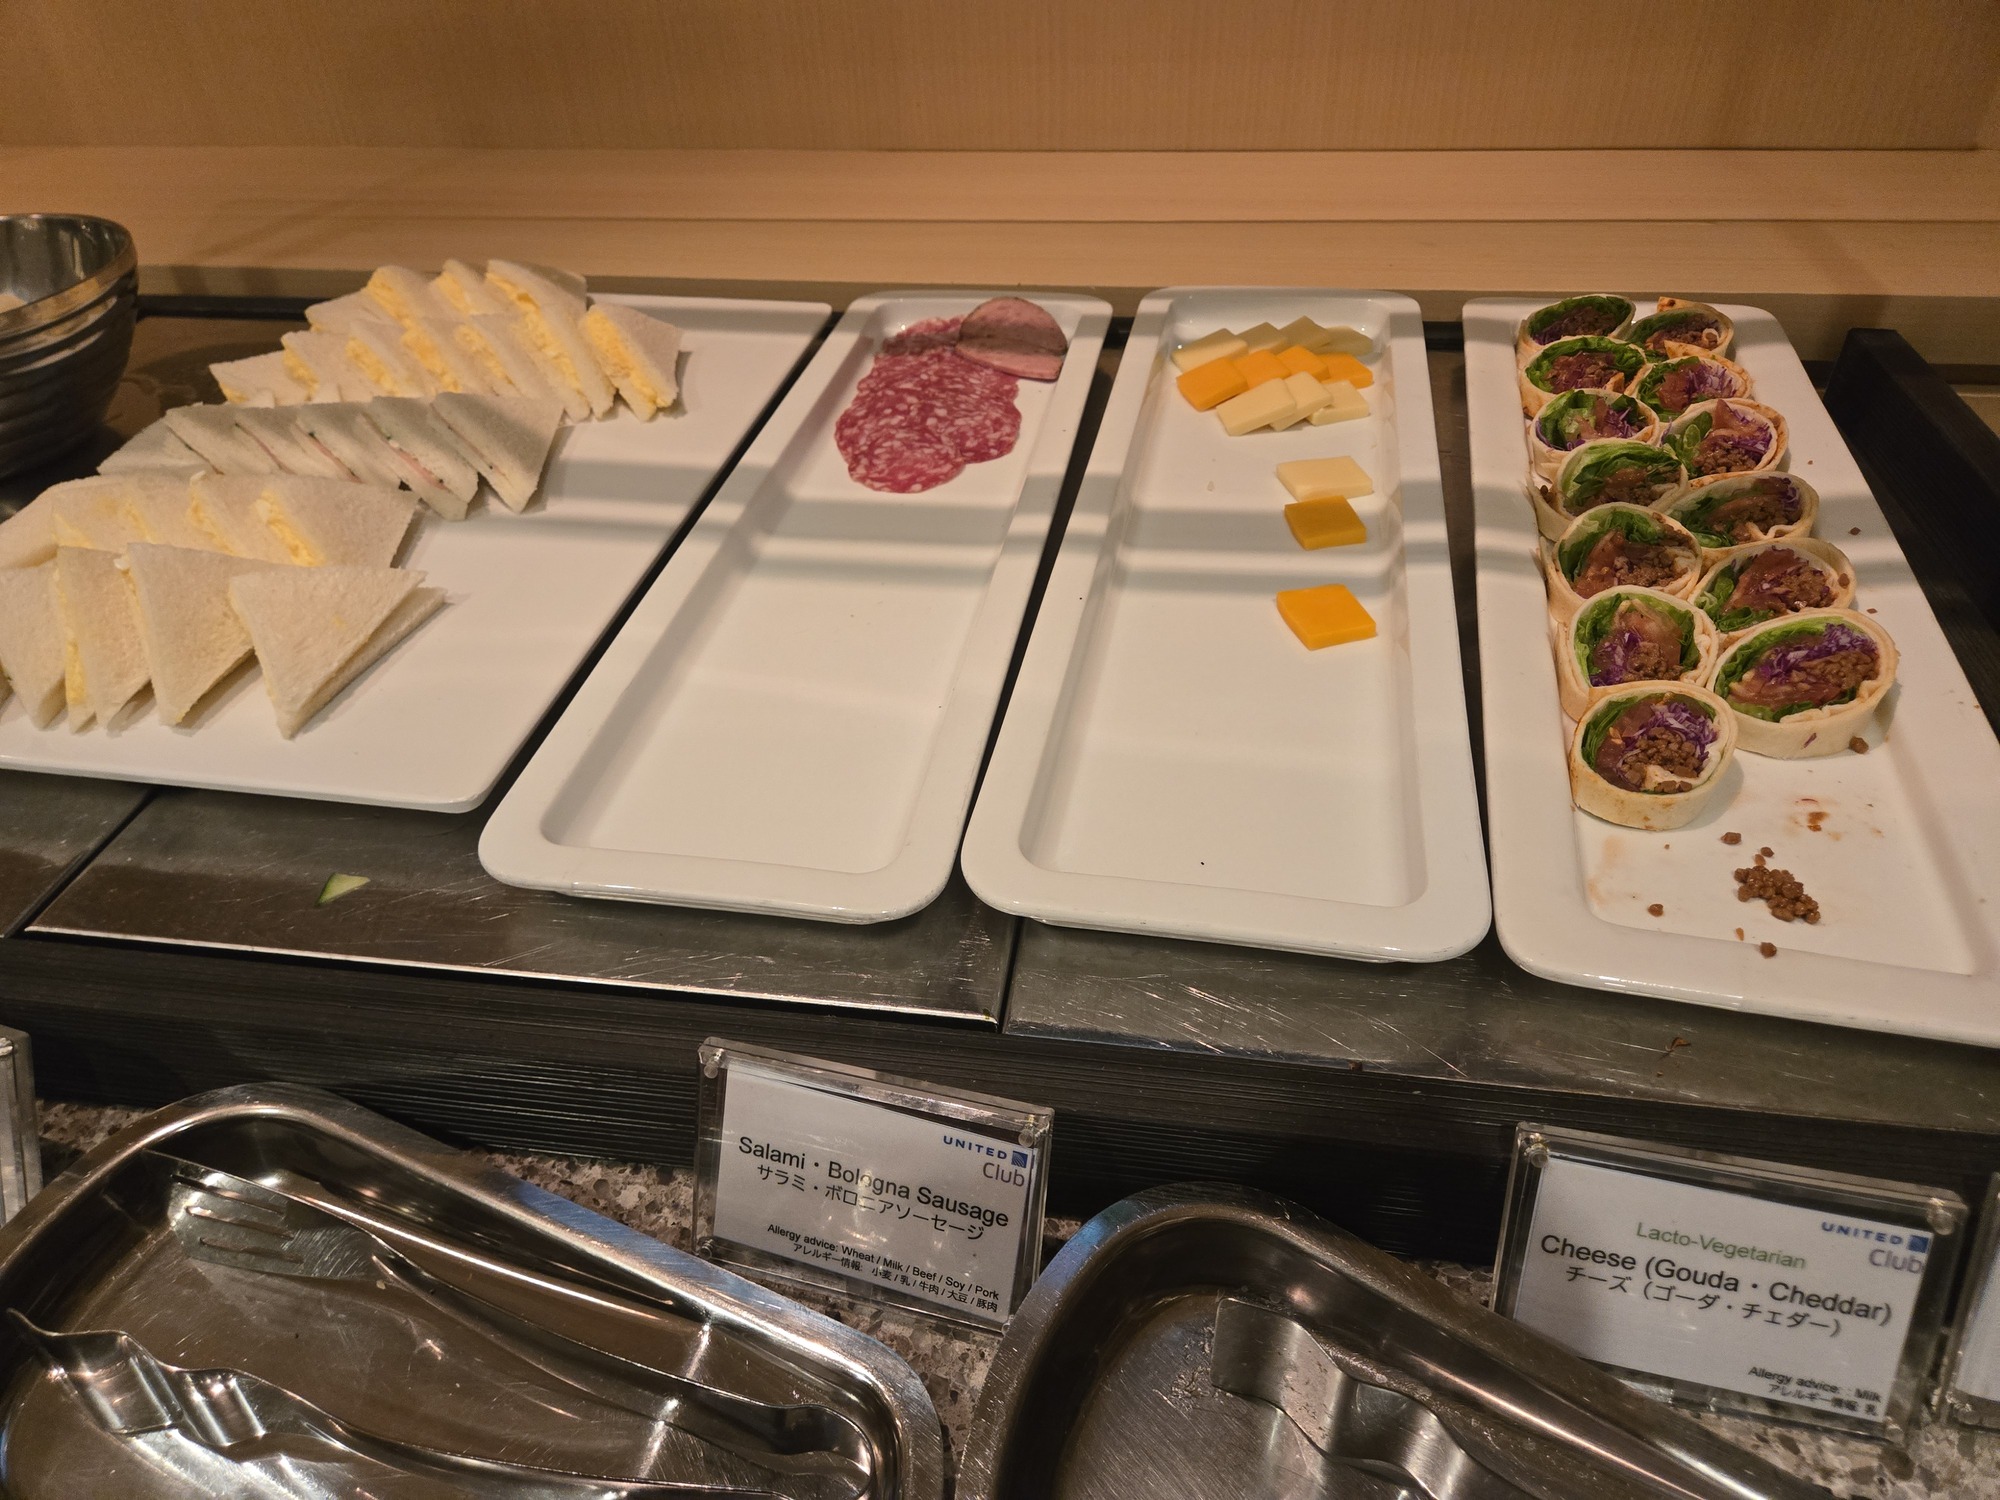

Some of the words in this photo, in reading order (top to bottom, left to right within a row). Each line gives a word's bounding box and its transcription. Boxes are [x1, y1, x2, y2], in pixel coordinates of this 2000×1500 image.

[943, 1135, 1008, 1160] UNITED
[739, 1136, 805, 1170] Salami
[828, 1161, 910, 1199] Bologna
[917, 1187, 1009, 1227] Sausage
[982, 1162, 1025, 1187] Club
[1636, 1223, 1807, 1270] Lacto-Vegetarian
[1821, 1221, 1904, 1246] UNITED
[767, 1224, 801, 1242] Allergy
[803, 1235, 838, 1253] advice:
[841, 1246, 875, 1263] Wheat
[883, 1256, 903, 1271] Milk
[913, 1266, 937, 1282] Beef
[945, 1276, 966, 1289] Soy
[974, 1285, 999, 1300] Pork
[1869, 1249, 1923, 1274] Club
[871, 1267, 892, 1281] 小麦
[900, 1275, 911, 1287] 乳
[919, 1281, 939, 1295] 牛肉
[948, 1289, 968, 1304] 大豆
[1540, 1235, 1637, 1270] Cheese
[1645, 1256, 1739, 1293] (Gouda
[1769, 1282, 1893, 1325] Cheddar)
[1748, 1366, 1792, 1387] Allergy
